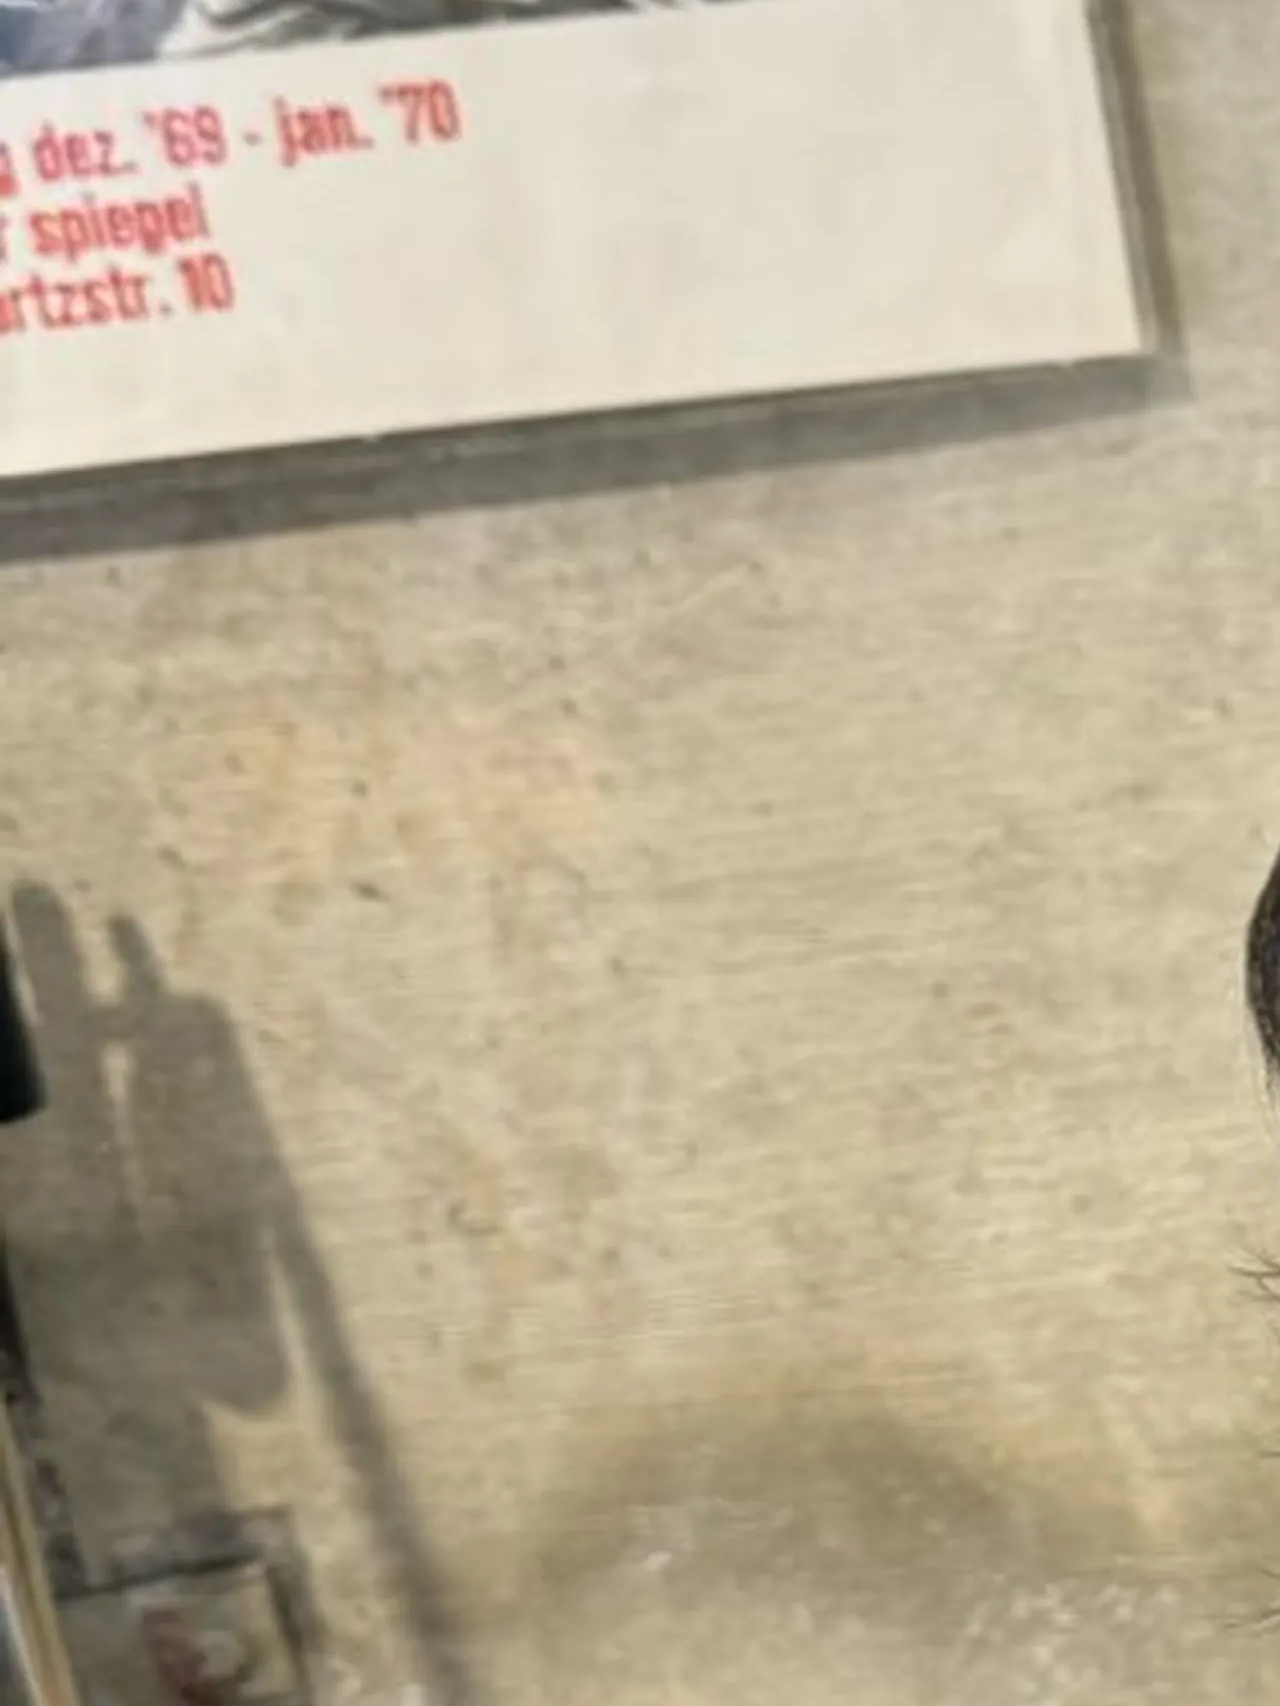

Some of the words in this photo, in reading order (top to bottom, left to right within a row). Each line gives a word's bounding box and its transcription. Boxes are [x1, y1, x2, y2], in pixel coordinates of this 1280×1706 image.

[33, 123, 137, 181] dez.
[272, 95, 373, 169] jan.
[30, 181, 210, 263] spiegel
[178, 253, 235, 311] 10
